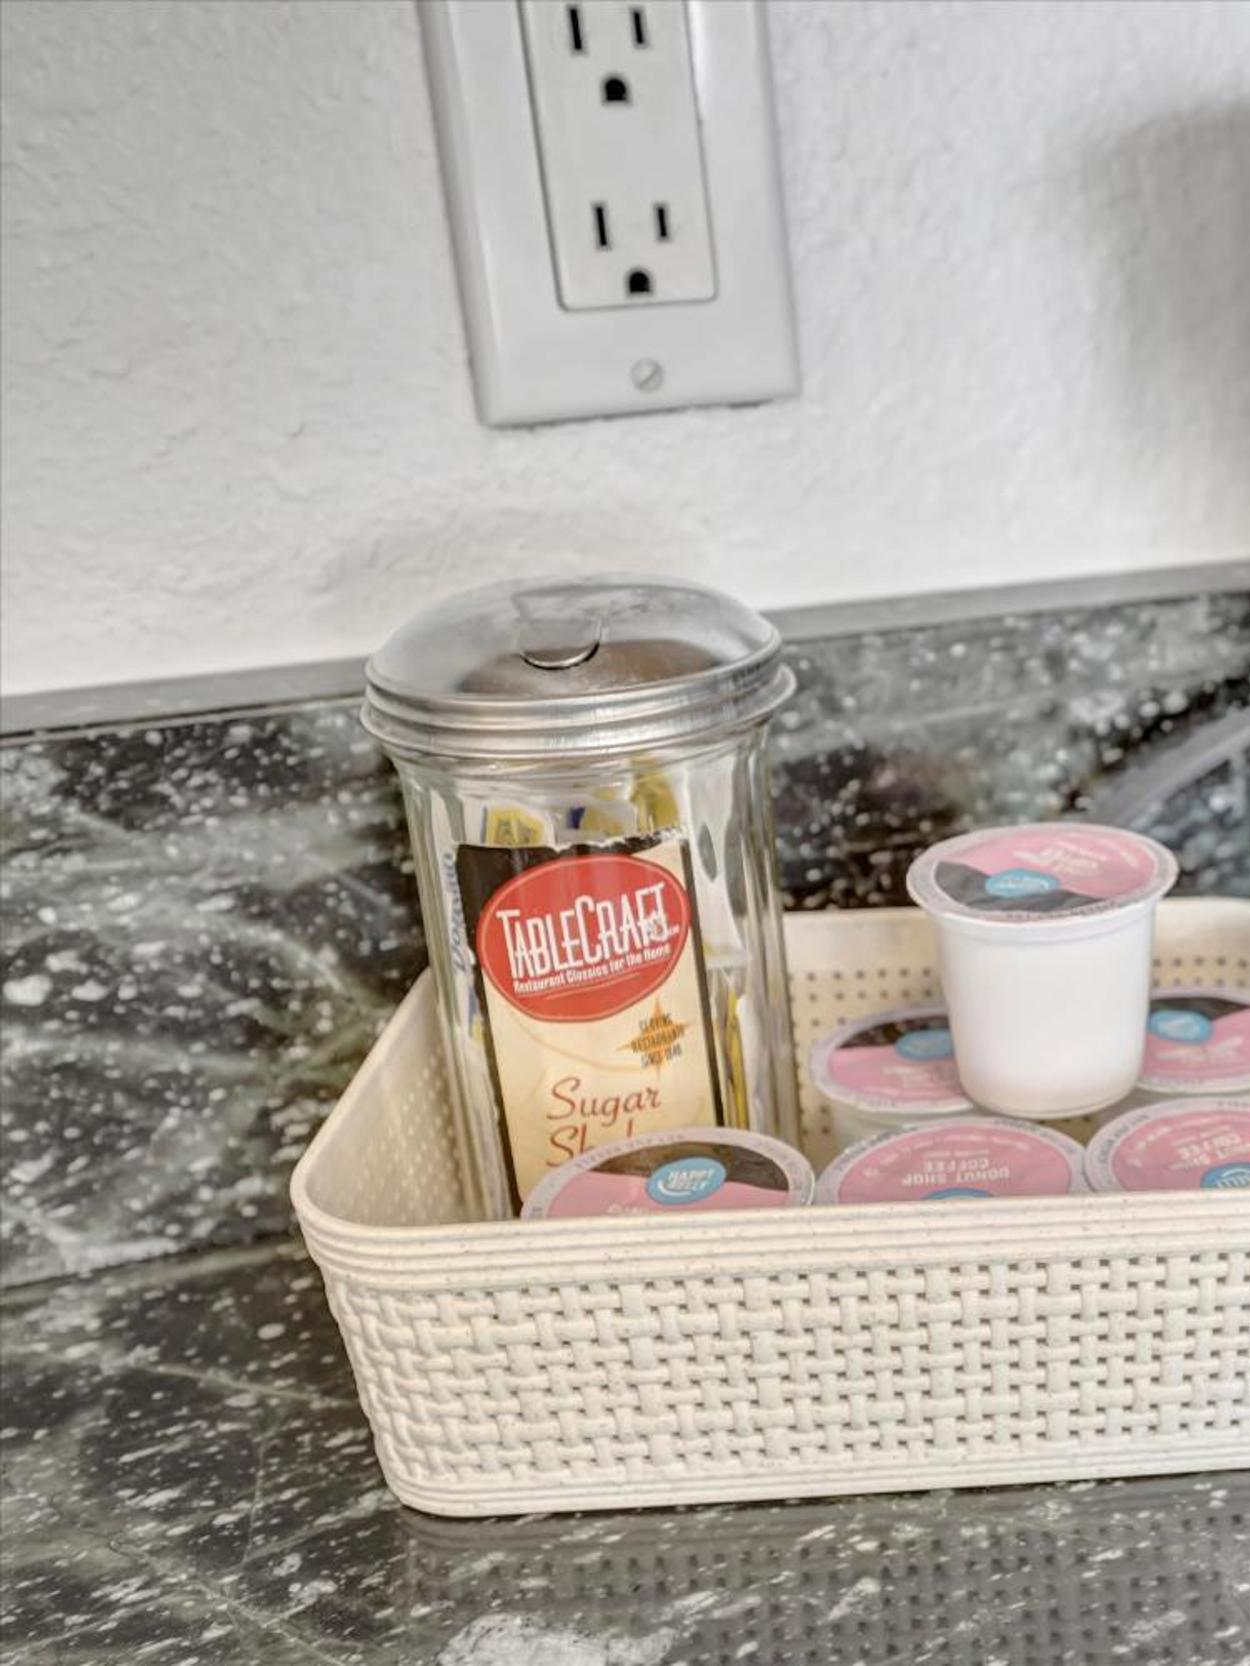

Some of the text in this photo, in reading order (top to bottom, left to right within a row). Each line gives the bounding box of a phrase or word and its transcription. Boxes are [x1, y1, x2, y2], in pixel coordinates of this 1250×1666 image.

[513, 973, 566, 994] Restaurant
[564, 963, 609, 985] Classics
[609, 956, 625, 974] for
[625, 951, 644, 968] the
[545, 1076, 661, 1128] Sugar
[900, 1167, 1010, 1187] DONUT SHOP
[923, 1158, 989, 1172] COFFEE
